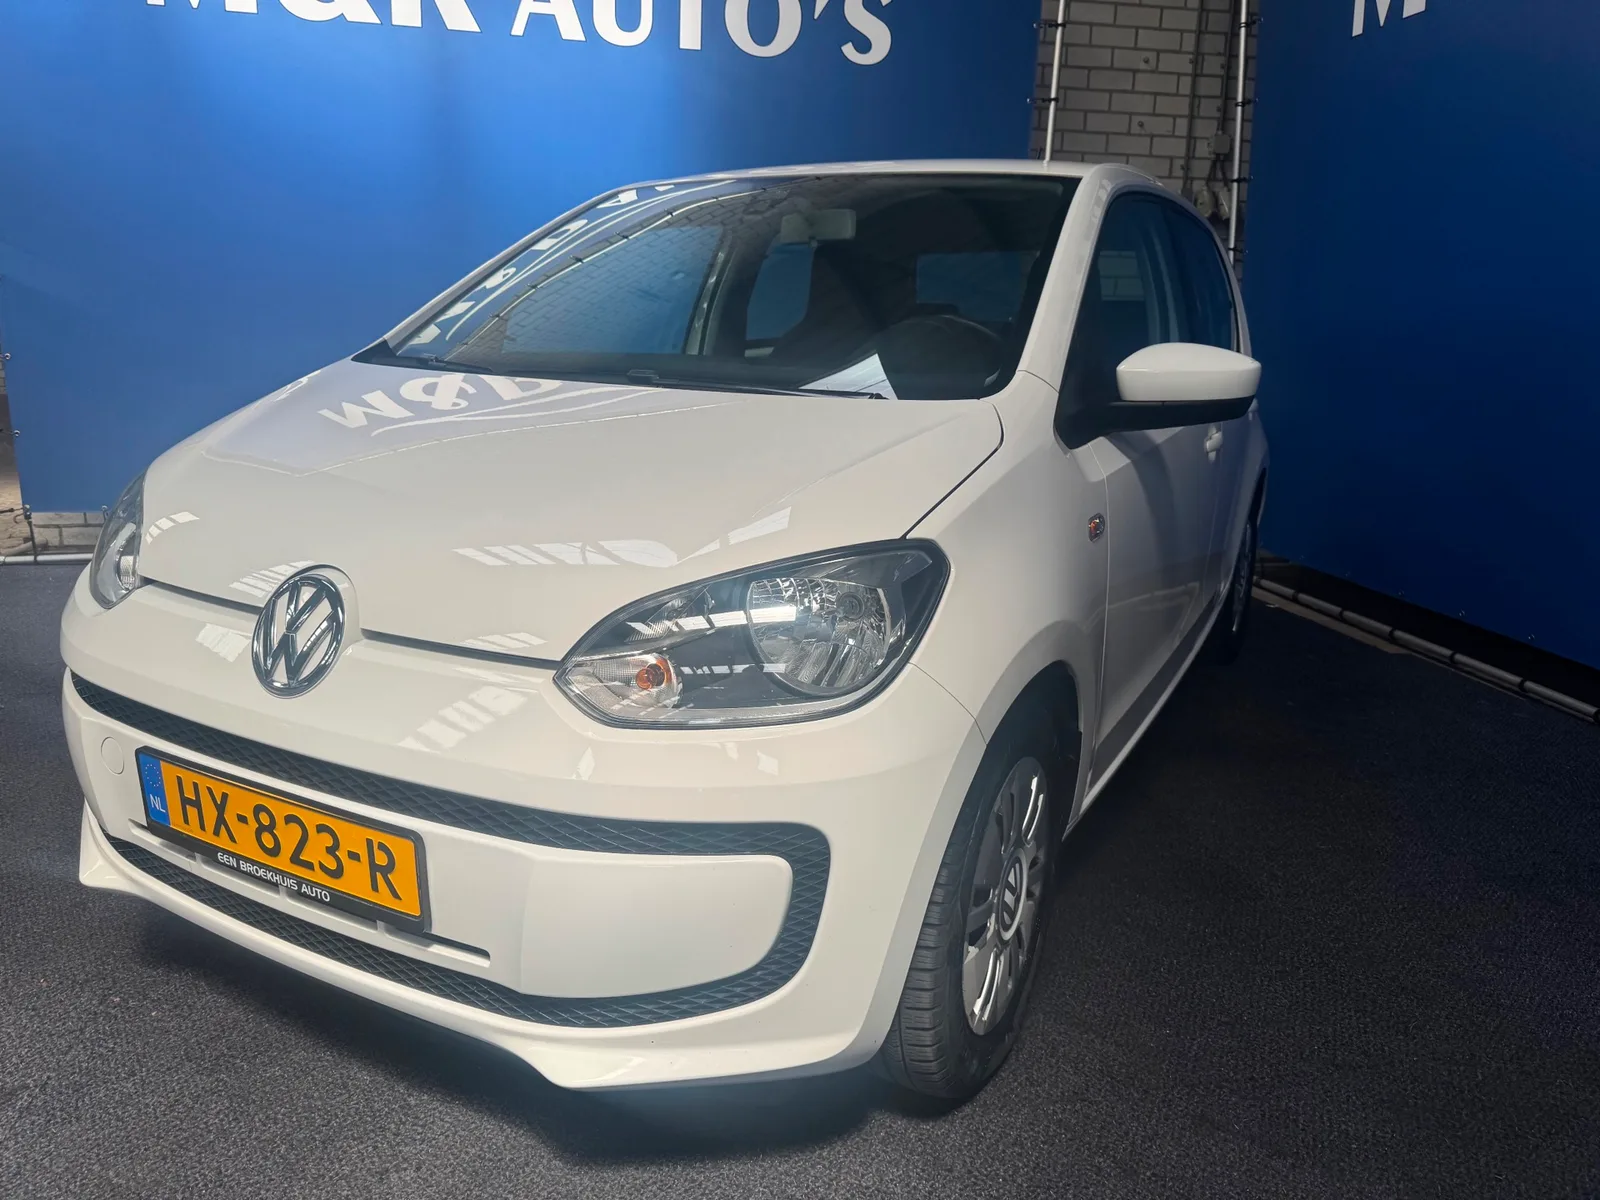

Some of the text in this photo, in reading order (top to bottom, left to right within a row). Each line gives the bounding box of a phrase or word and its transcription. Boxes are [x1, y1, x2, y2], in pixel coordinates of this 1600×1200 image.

[149, 793, 166, 813] NL
[176, 774, 402, 901] HX-823-R
[217, 852, 331, 902] EEN BROEKHUIS AUTO
